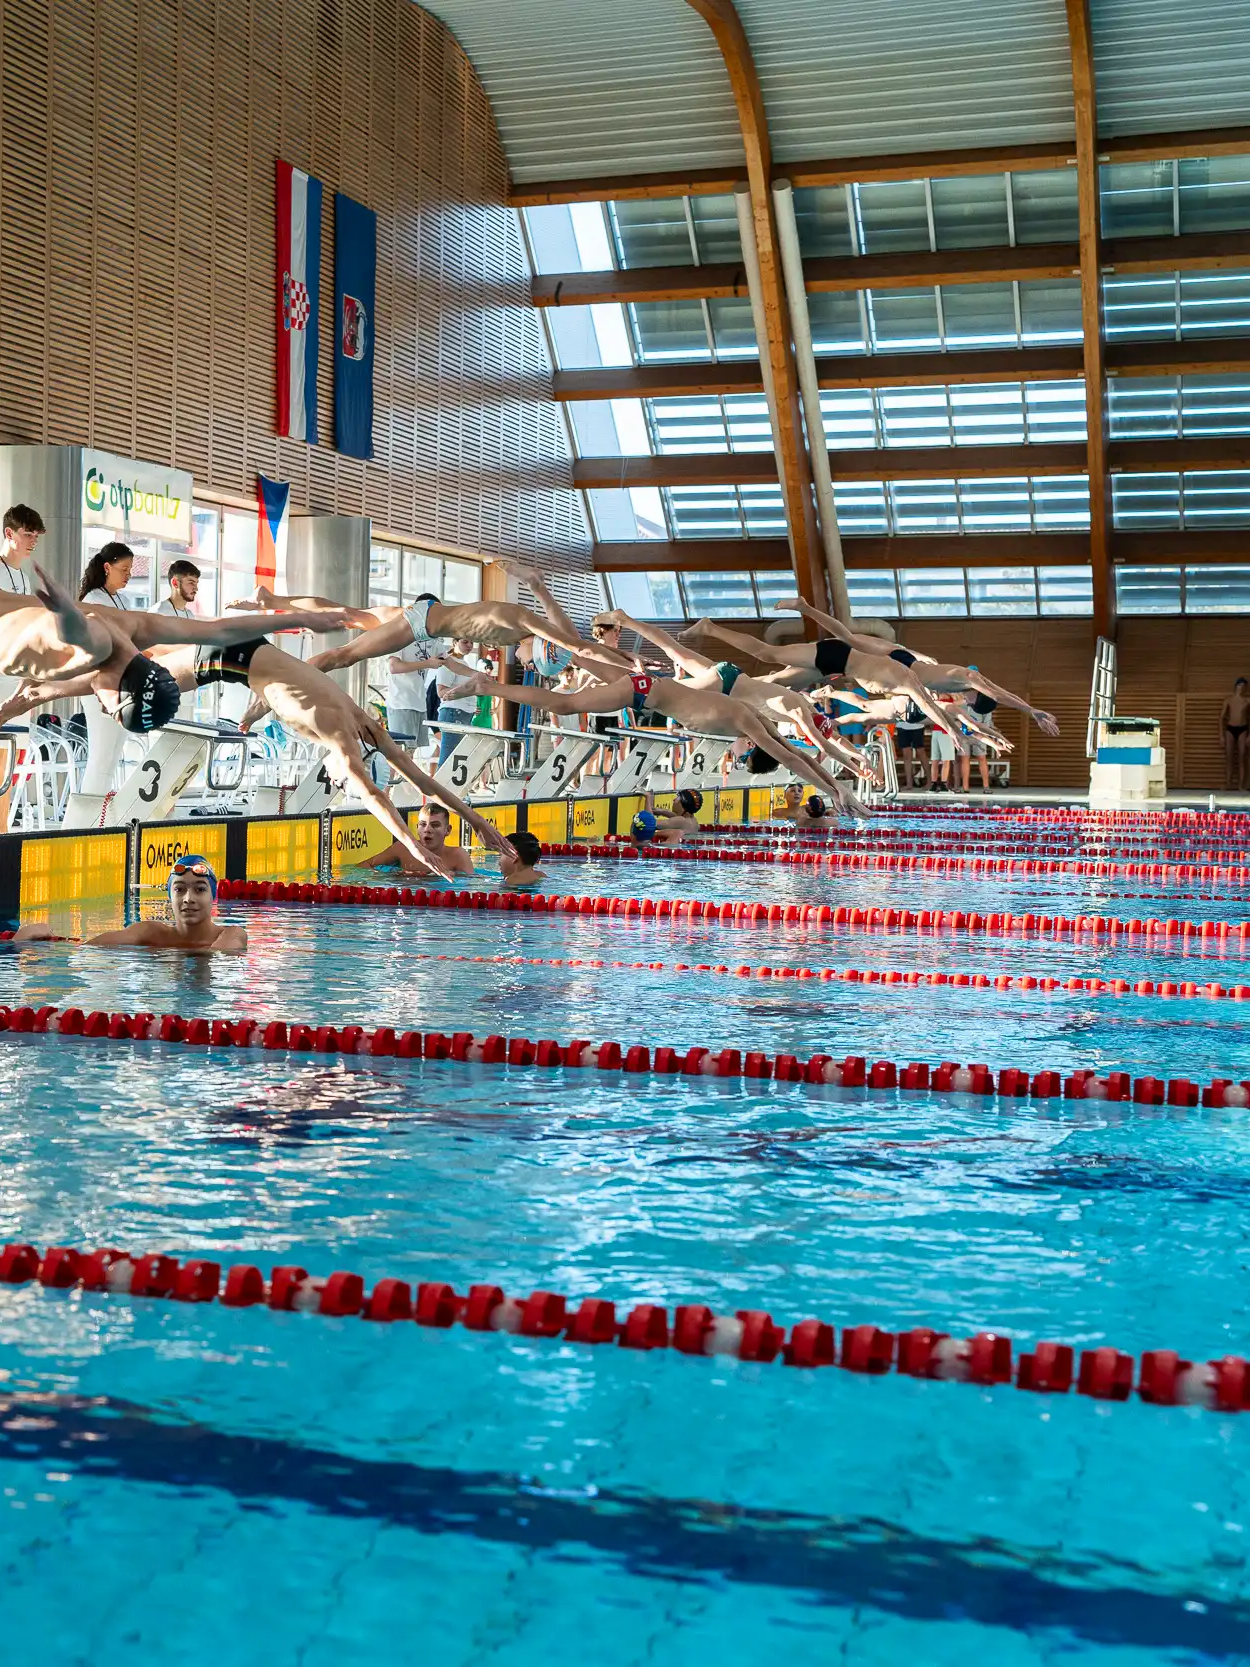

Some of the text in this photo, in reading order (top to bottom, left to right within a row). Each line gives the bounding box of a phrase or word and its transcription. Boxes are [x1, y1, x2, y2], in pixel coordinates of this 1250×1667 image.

[110, 479, 181, 521] otpbank
[451, 754, 468, 786] 5
[551, 754, 567, 783] 6
[635, 751, 648, 777] 7
[692, 752, 705, 776] 8
[139, 760, 199, 802] 3 3
[316, 765, 332, 795] 4
[575, 810, 596, 827] OMEGA
[335, 827, 368, 852] OMEGA
